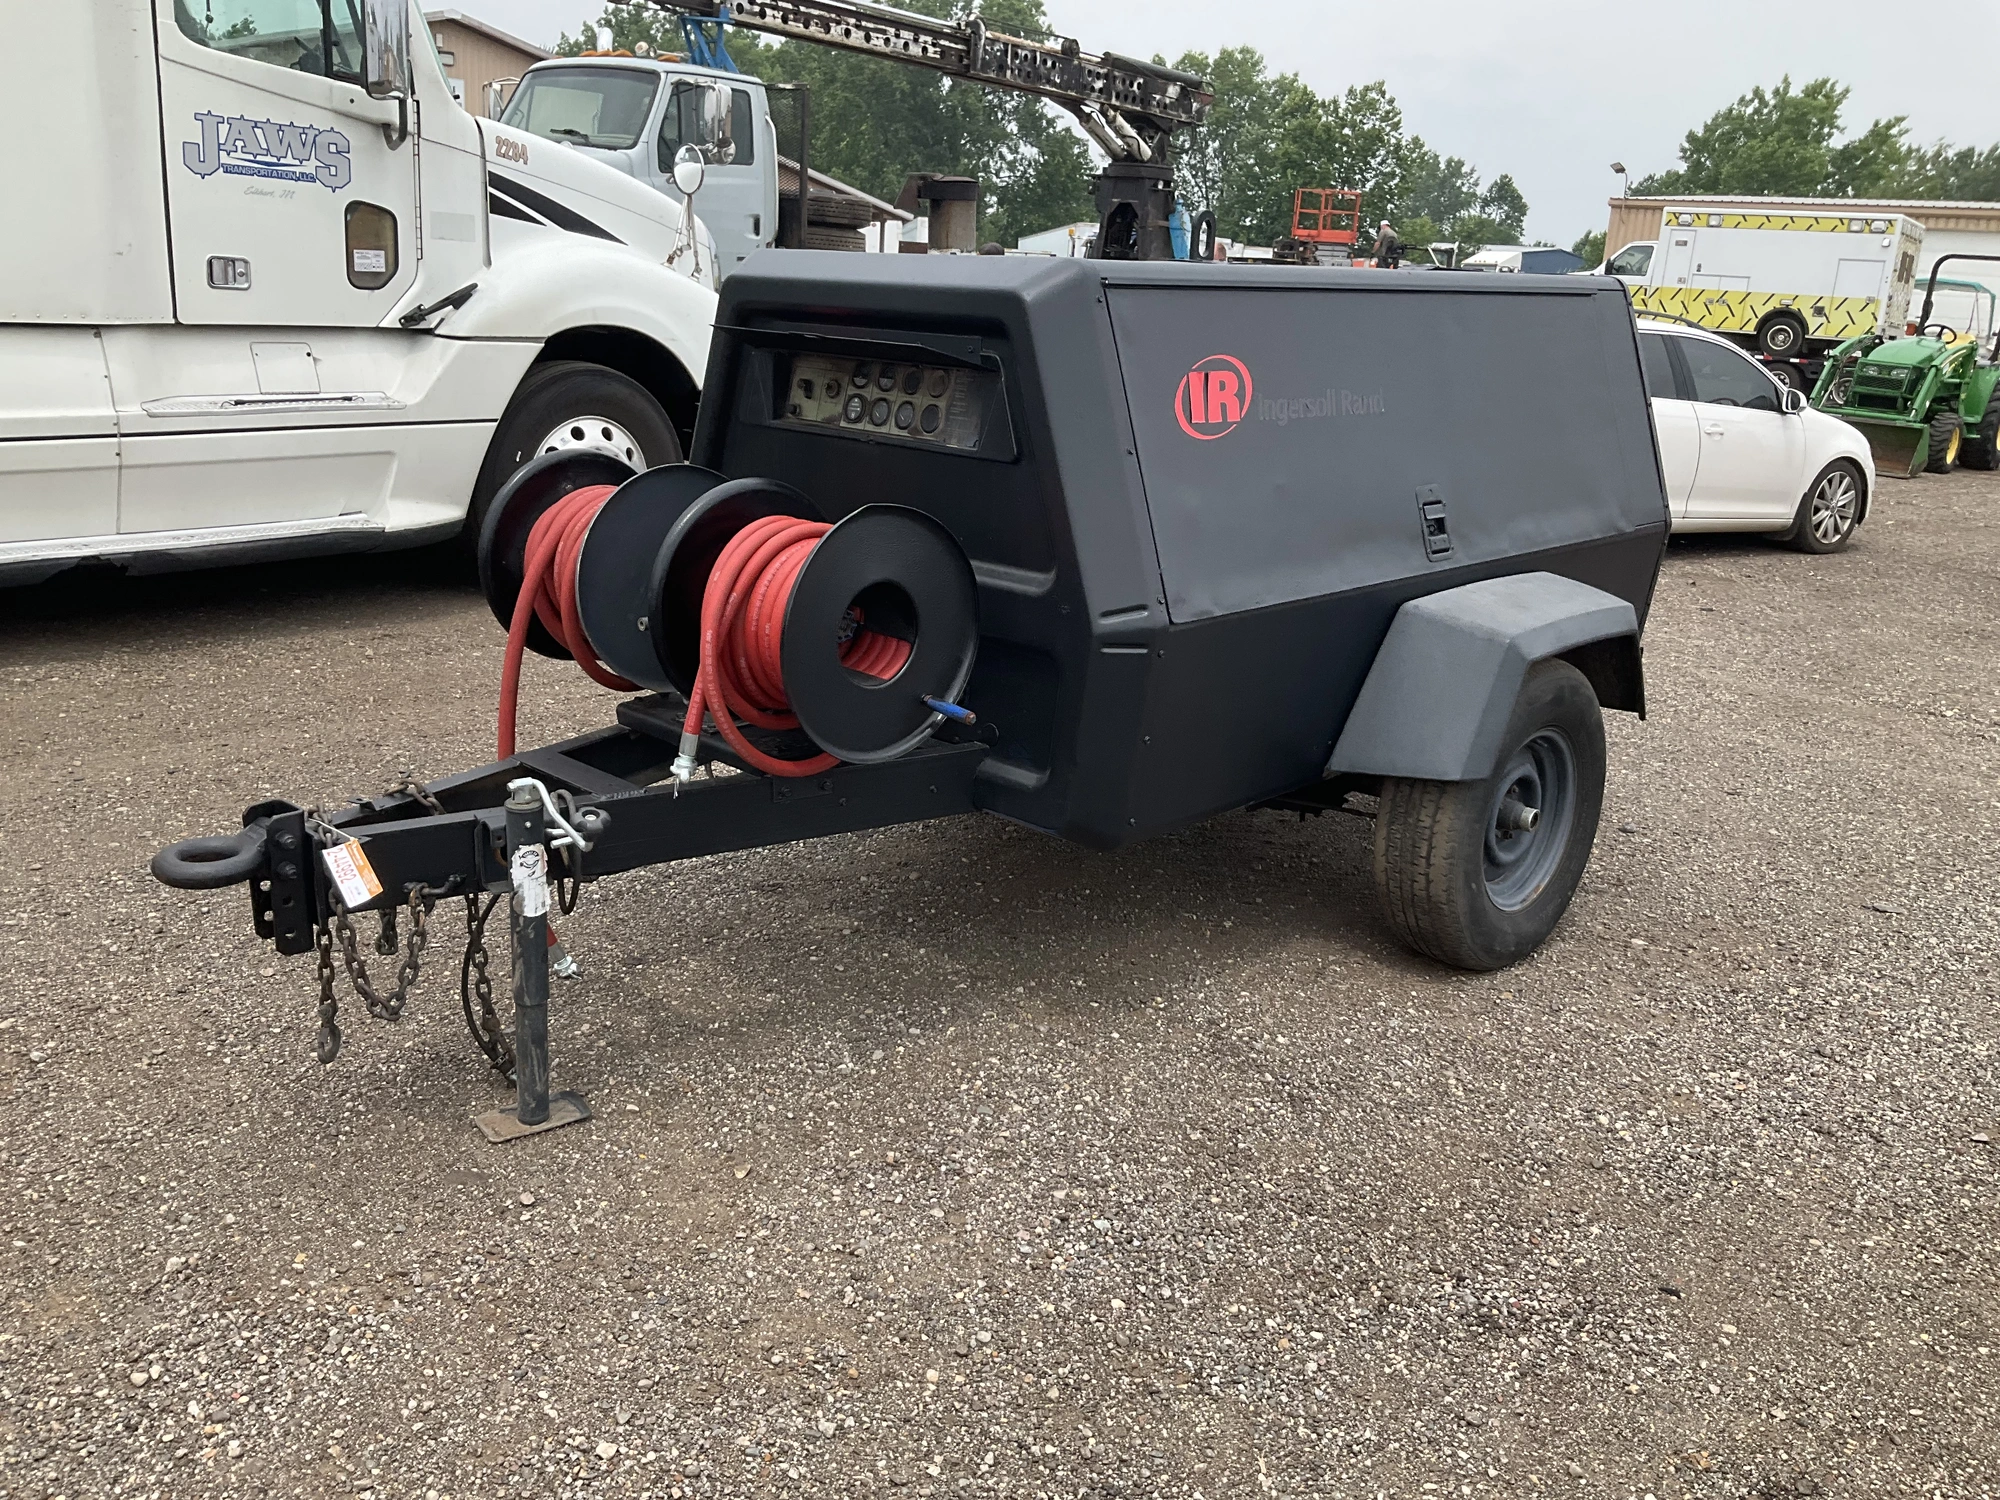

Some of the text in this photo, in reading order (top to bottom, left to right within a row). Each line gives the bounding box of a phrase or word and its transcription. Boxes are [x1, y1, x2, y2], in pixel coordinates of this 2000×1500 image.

[182, 110, 351, 193] JAWS
[495, 135, 529, 166] 2284
[221, 163, 299, 182] TRANSPORTATION,
[1188, 370, 1241, 423] IR
[1257, 388, 1336, 427] Ingersoll
[326, 847, 358, 885] 2-44992
